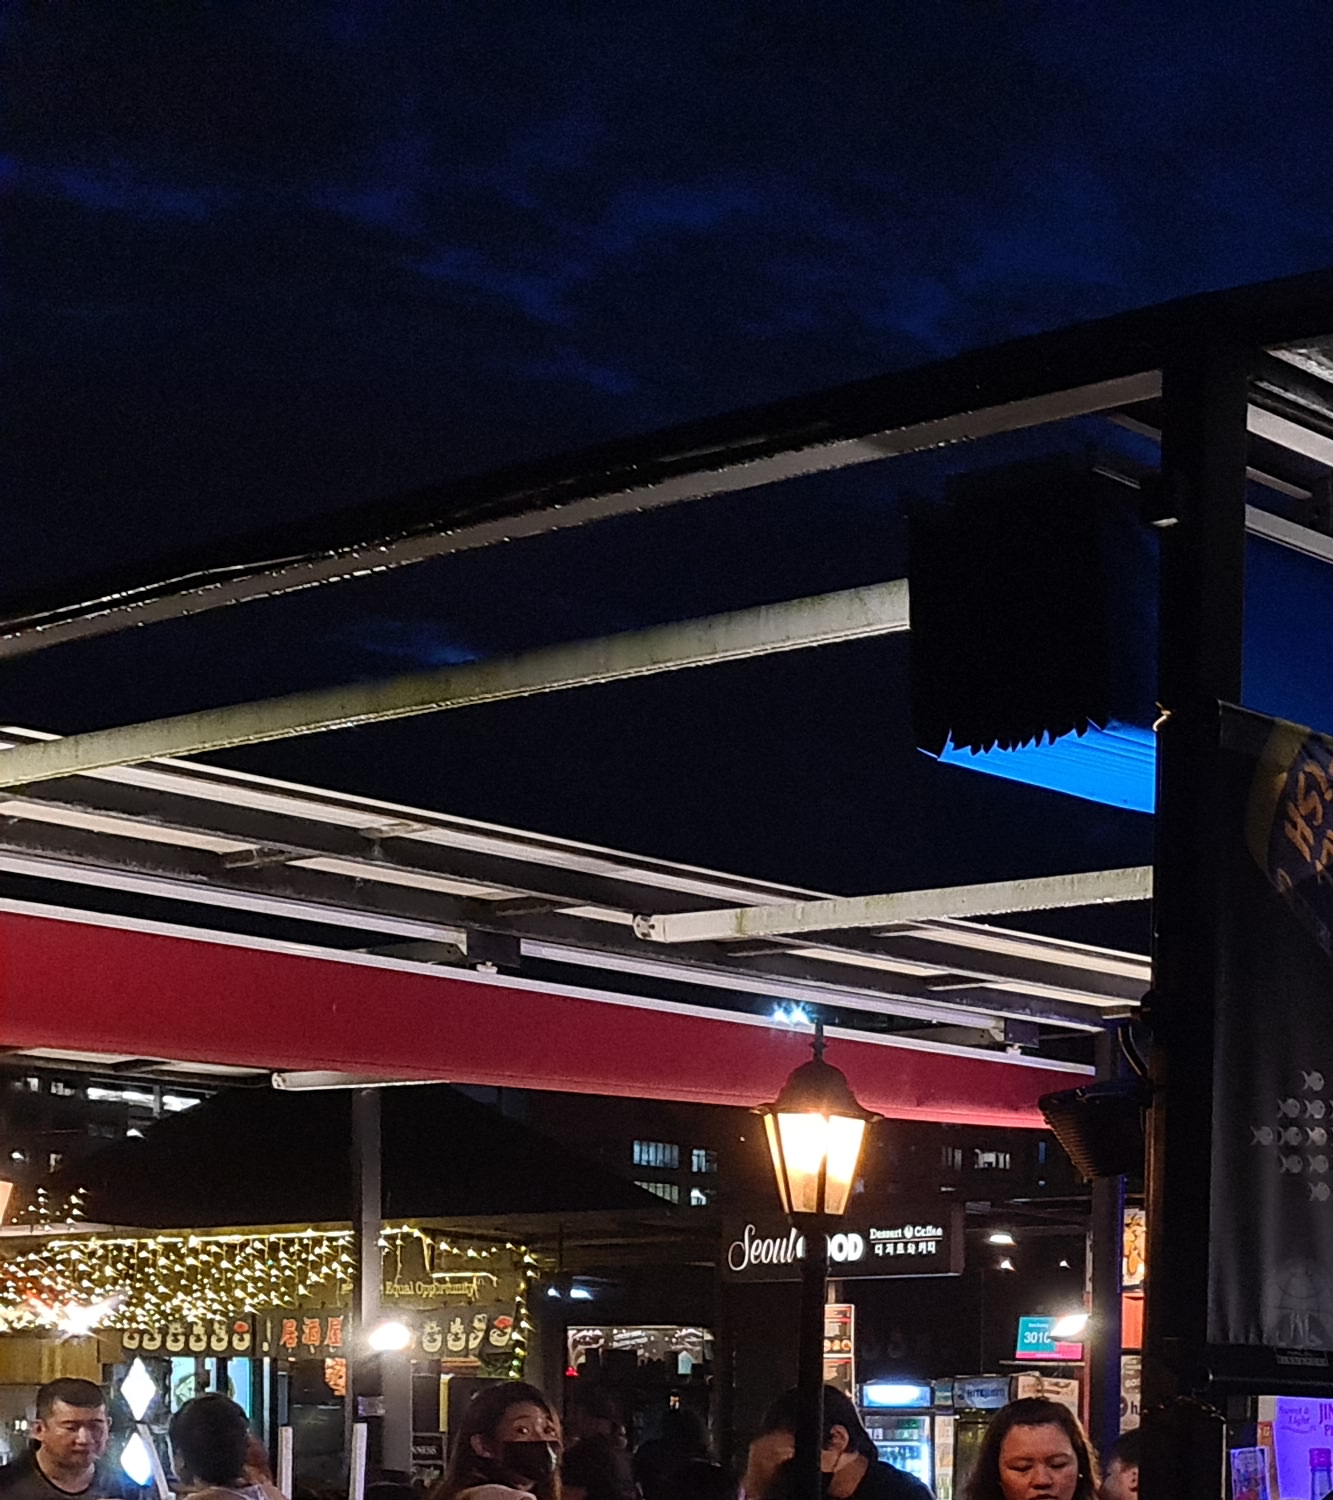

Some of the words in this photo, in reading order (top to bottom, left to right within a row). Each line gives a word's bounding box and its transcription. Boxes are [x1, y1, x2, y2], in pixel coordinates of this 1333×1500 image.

[728, 1224, 798, 1271] Seoul
[385, 1281, 415, 1298] Equal
[415, 1281, 473, 1299] Opportunity
[280, 1316, 344, 1350] 居酒屋
